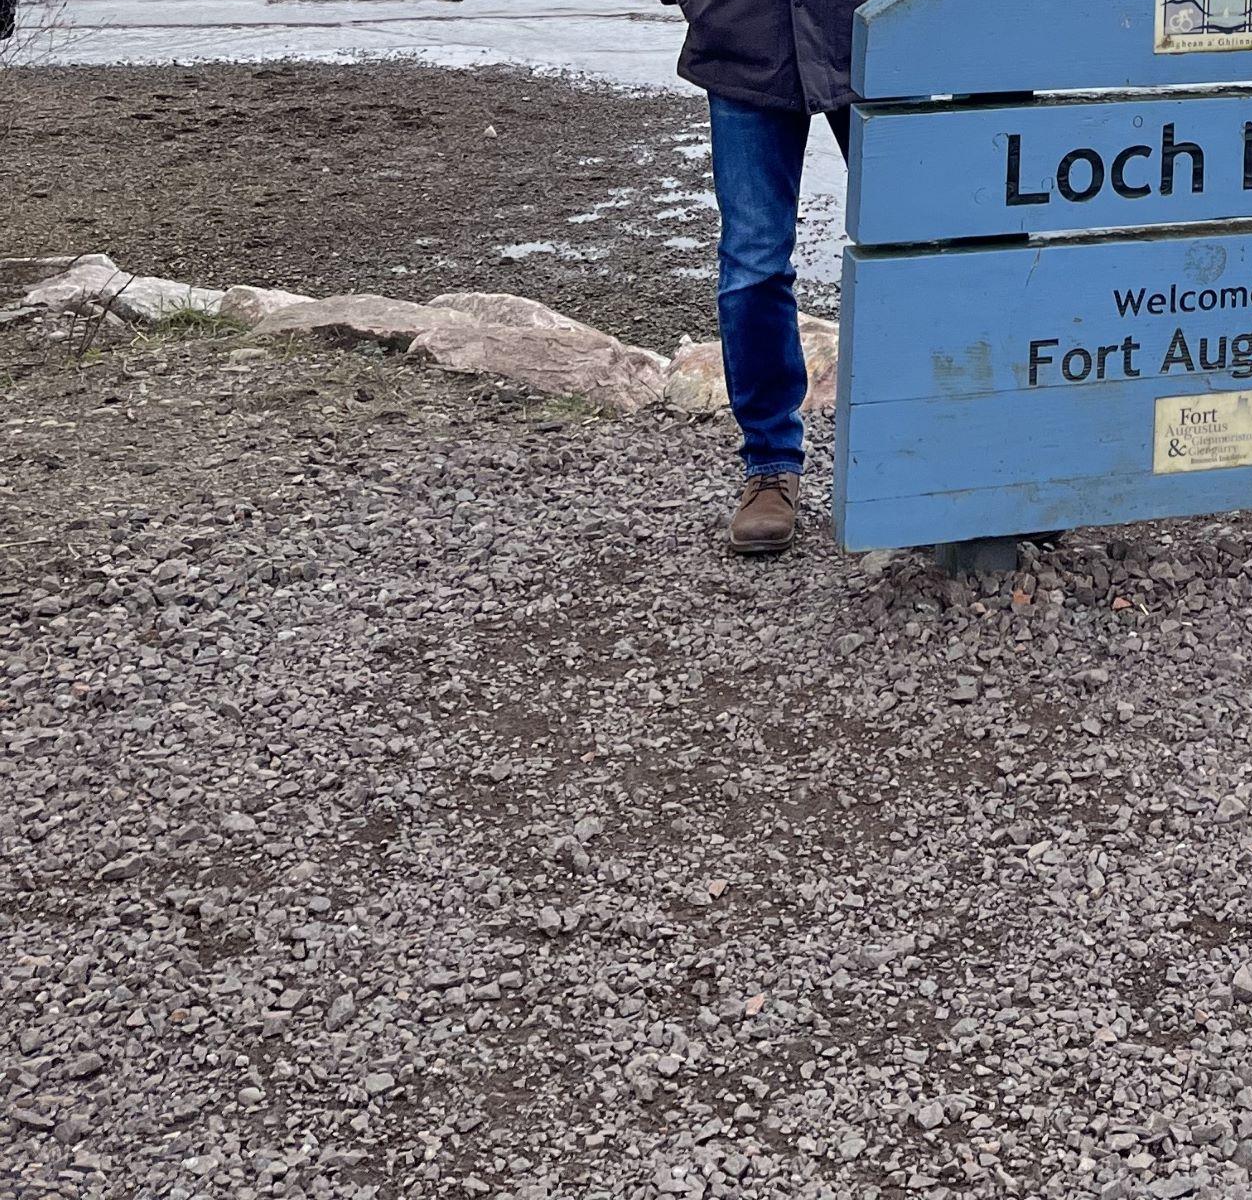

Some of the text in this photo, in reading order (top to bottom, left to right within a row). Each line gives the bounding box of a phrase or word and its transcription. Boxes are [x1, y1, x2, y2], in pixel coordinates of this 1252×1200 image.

[1005, 122, 1204, 206] Loch
[1028, 335, 1141, 386] Fort
[1180, 407, 1218, 426] Fort
[1165, 422, 1229, 440] Augustus
[1168, 438, 1187, 458] &
